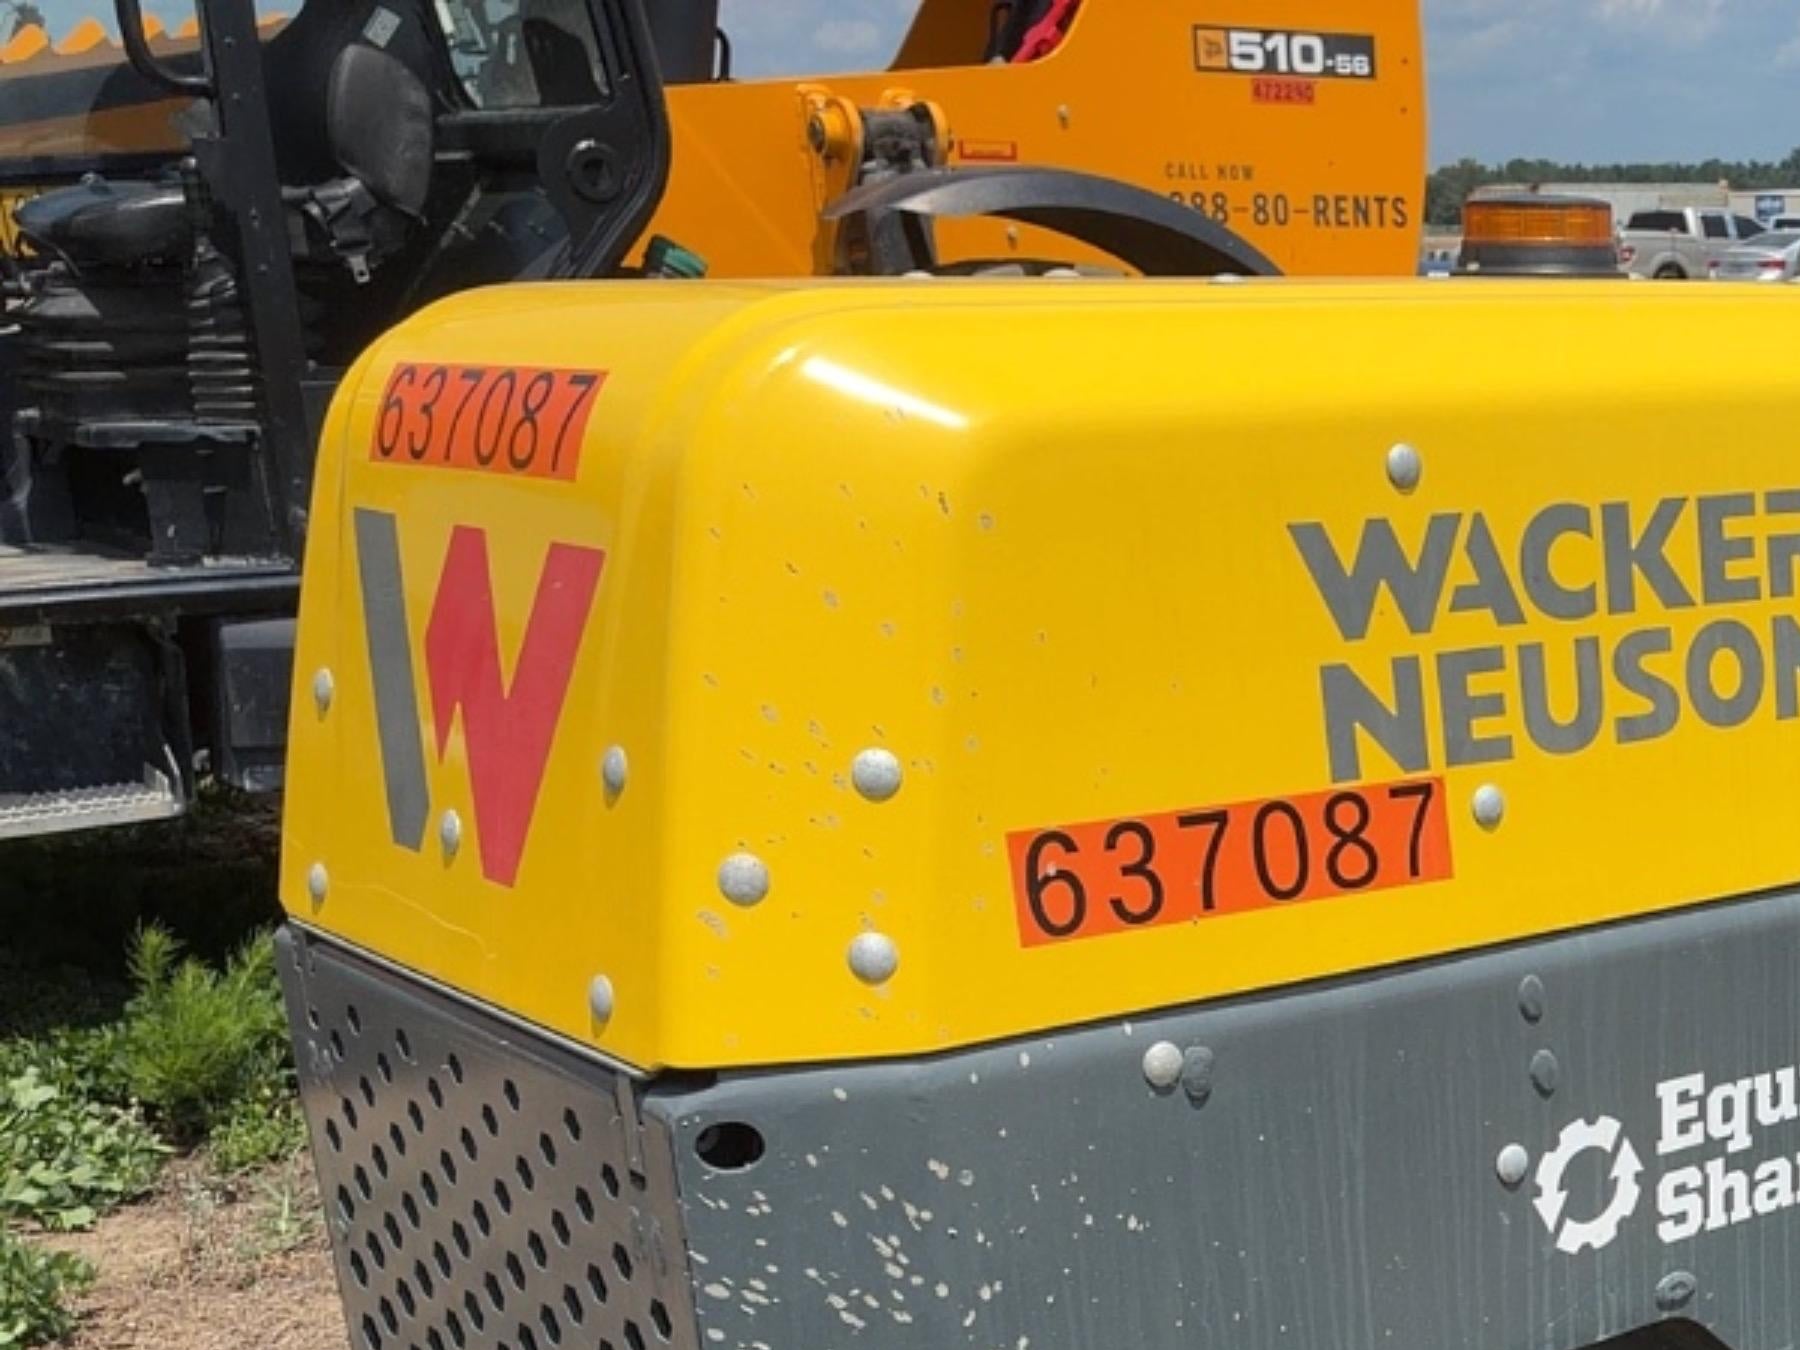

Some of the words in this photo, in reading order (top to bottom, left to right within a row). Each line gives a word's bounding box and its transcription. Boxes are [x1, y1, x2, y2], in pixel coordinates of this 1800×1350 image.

[1228, 30, 1371, 75] 510-56
[1164, 162, 1208, 181] CALL
[1217, 164, 1254, 181] NOW
[377, 365, 597, 472] 637087
[1024, 782, 1434, 938] 637087
